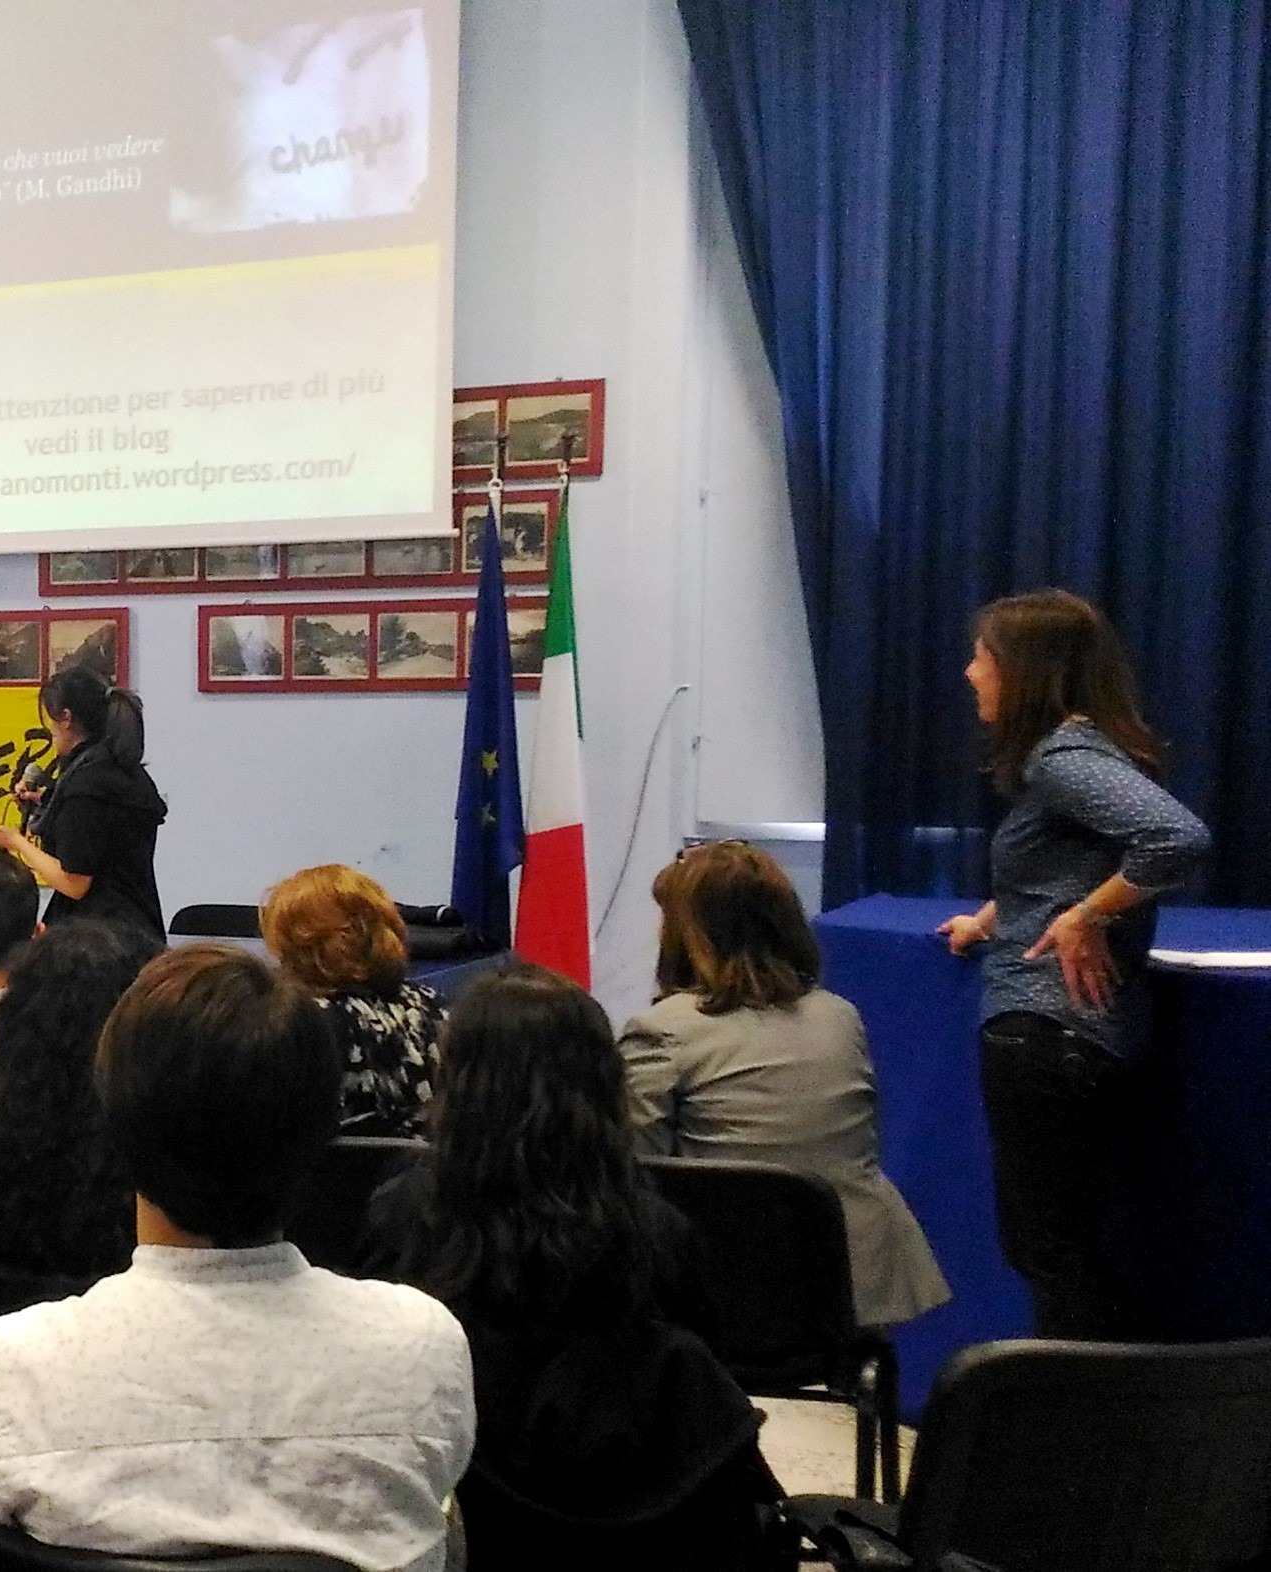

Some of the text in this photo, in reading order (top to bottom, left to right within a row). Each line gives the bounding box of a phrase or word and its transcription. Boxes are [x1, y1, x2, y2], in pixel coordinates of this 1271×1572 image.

[3, 148, 38, 171] che
[44, 140, 90, 167] vuoi
[94, 134, 164, 160] vedere
[16, 178, 51, 204] (M.
[56, 166, 142, 196] Gandhi)
[128, 389, 174, 417] per
[182, 380, 294, 412] saperne
[302, 372, 329, 398] di
[339, 368, 386, 403] più
[25, 425, 170, 456] vedi il blog
